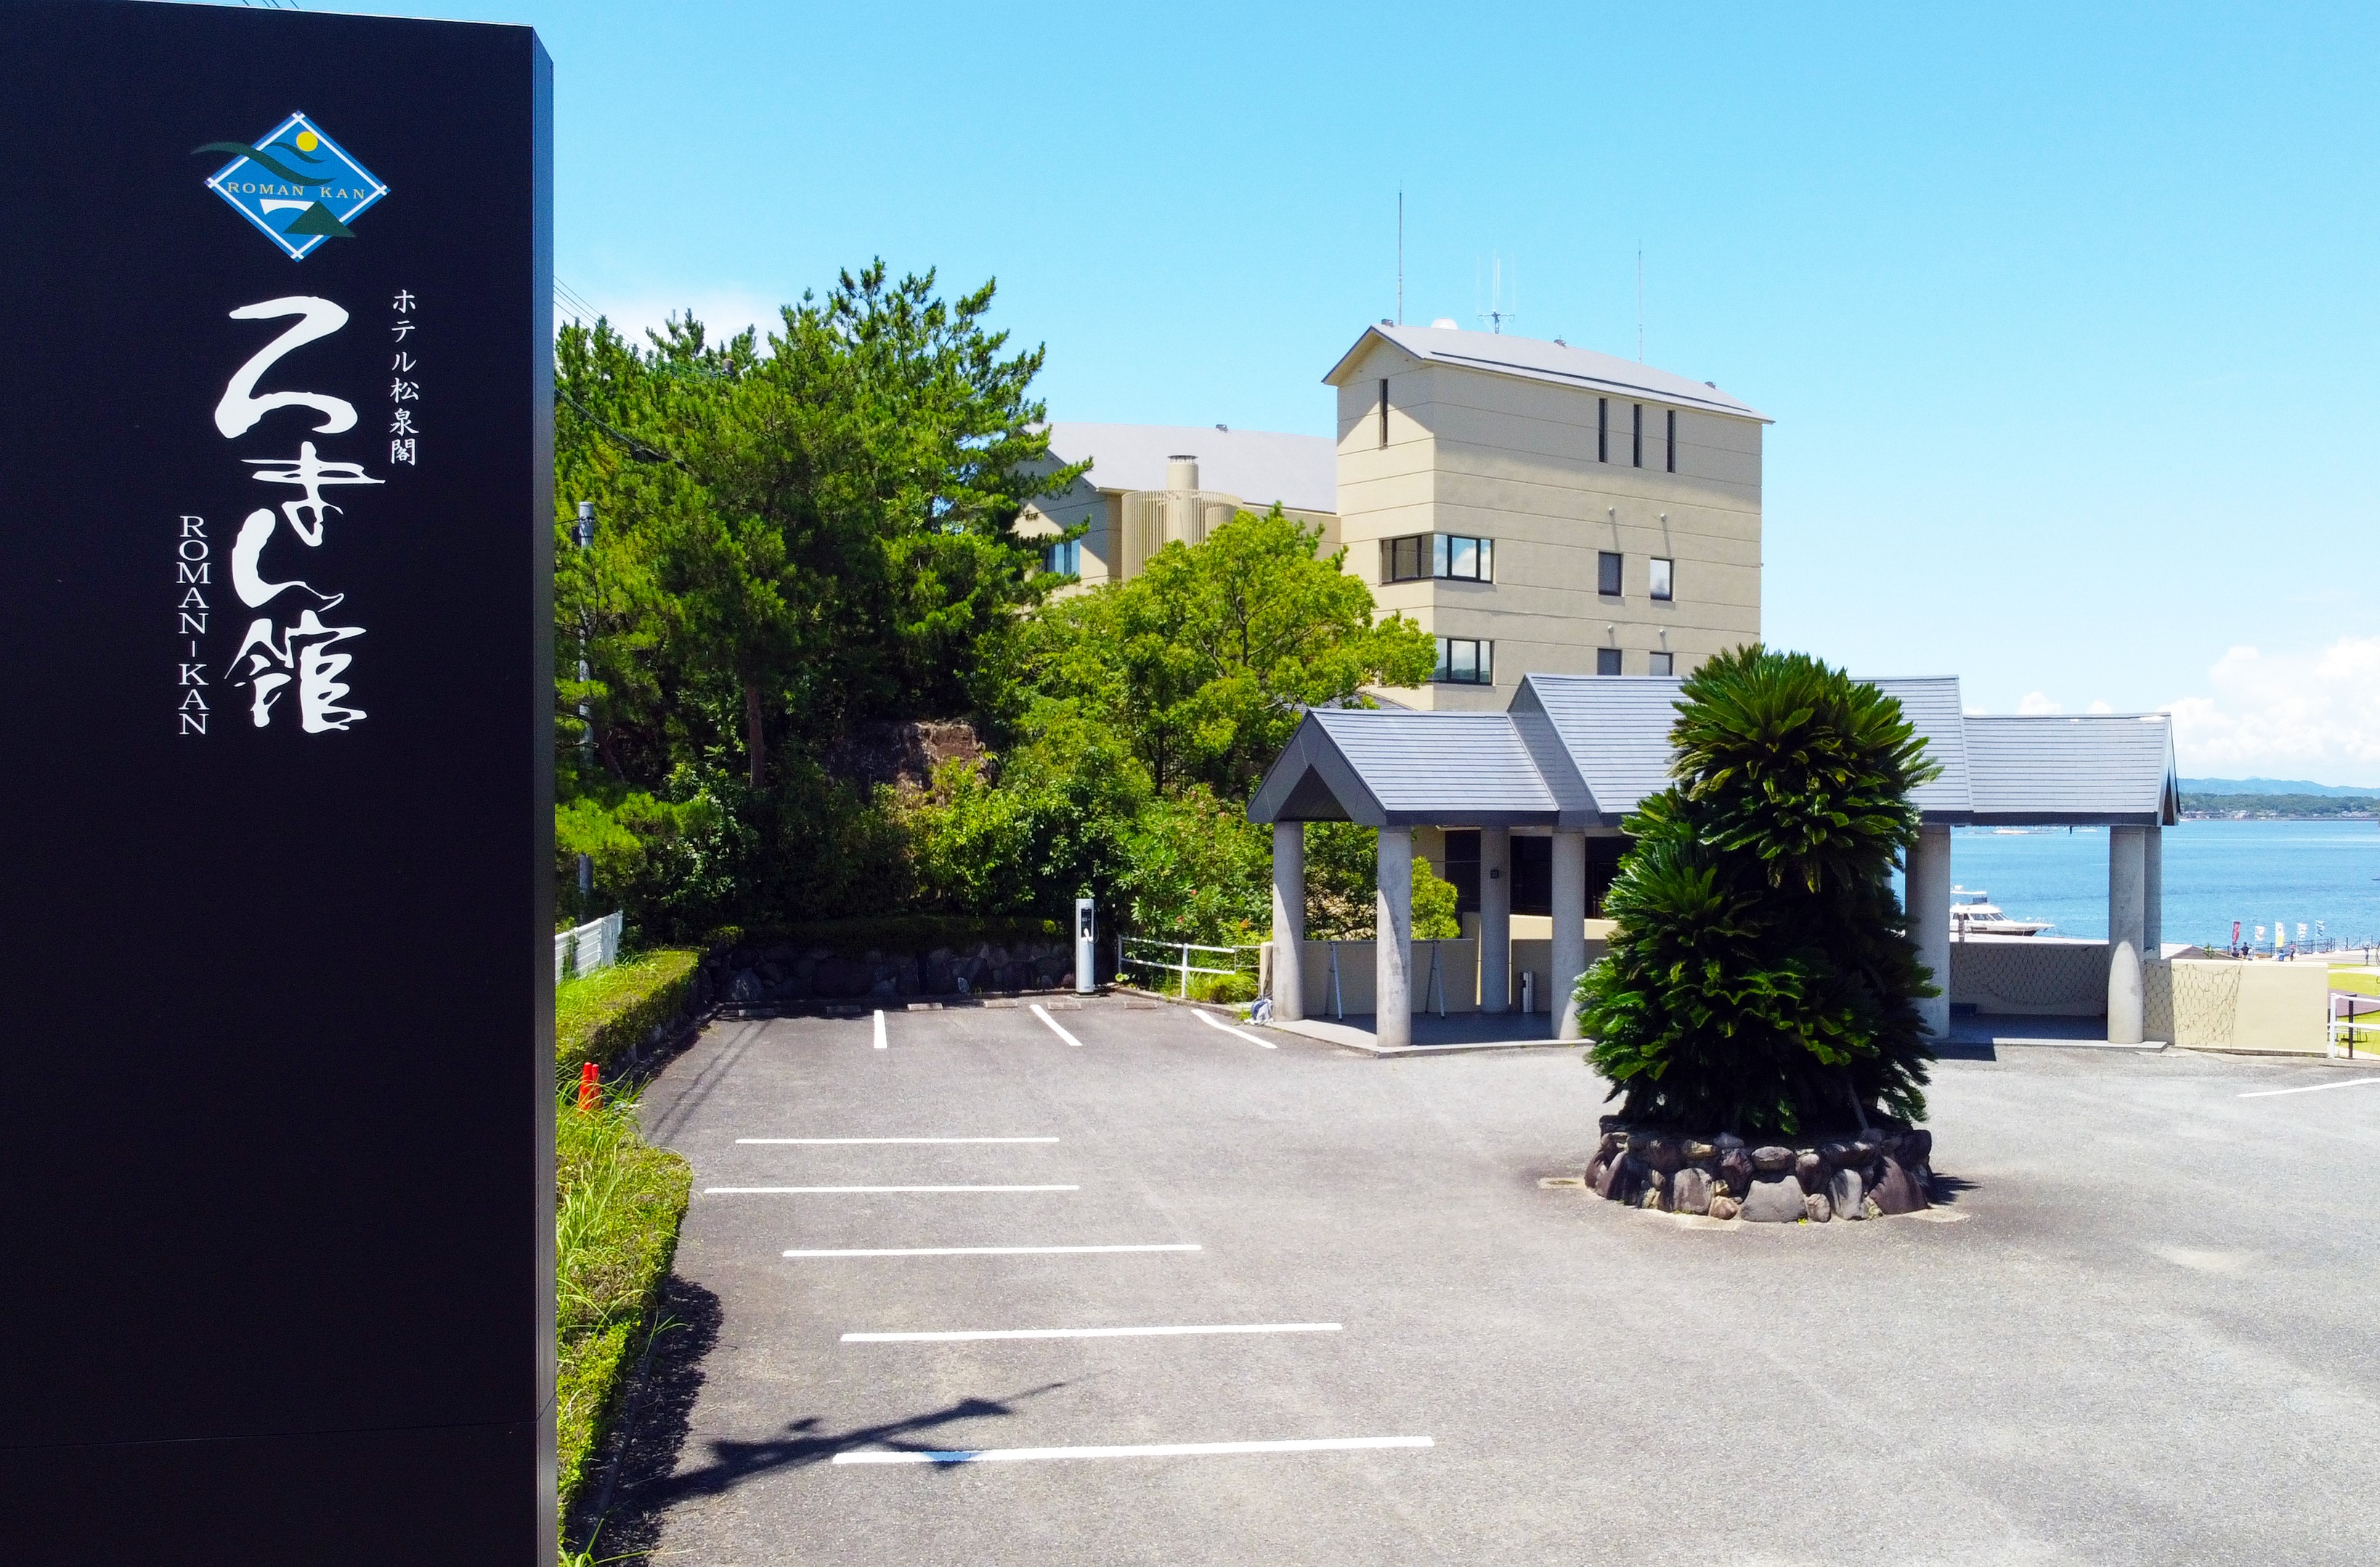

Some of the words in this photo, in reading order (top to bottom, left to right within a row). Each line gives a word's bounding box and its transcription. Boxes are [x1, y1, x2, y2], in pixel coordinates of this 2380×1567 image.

[227, 182, 304, 197] ROMAN
[320, 187, 365, 200] KAN
[389, 289, 420, 466] ホテル松泉閣
[176, 516, 211, 735] ROMAN-KAN
